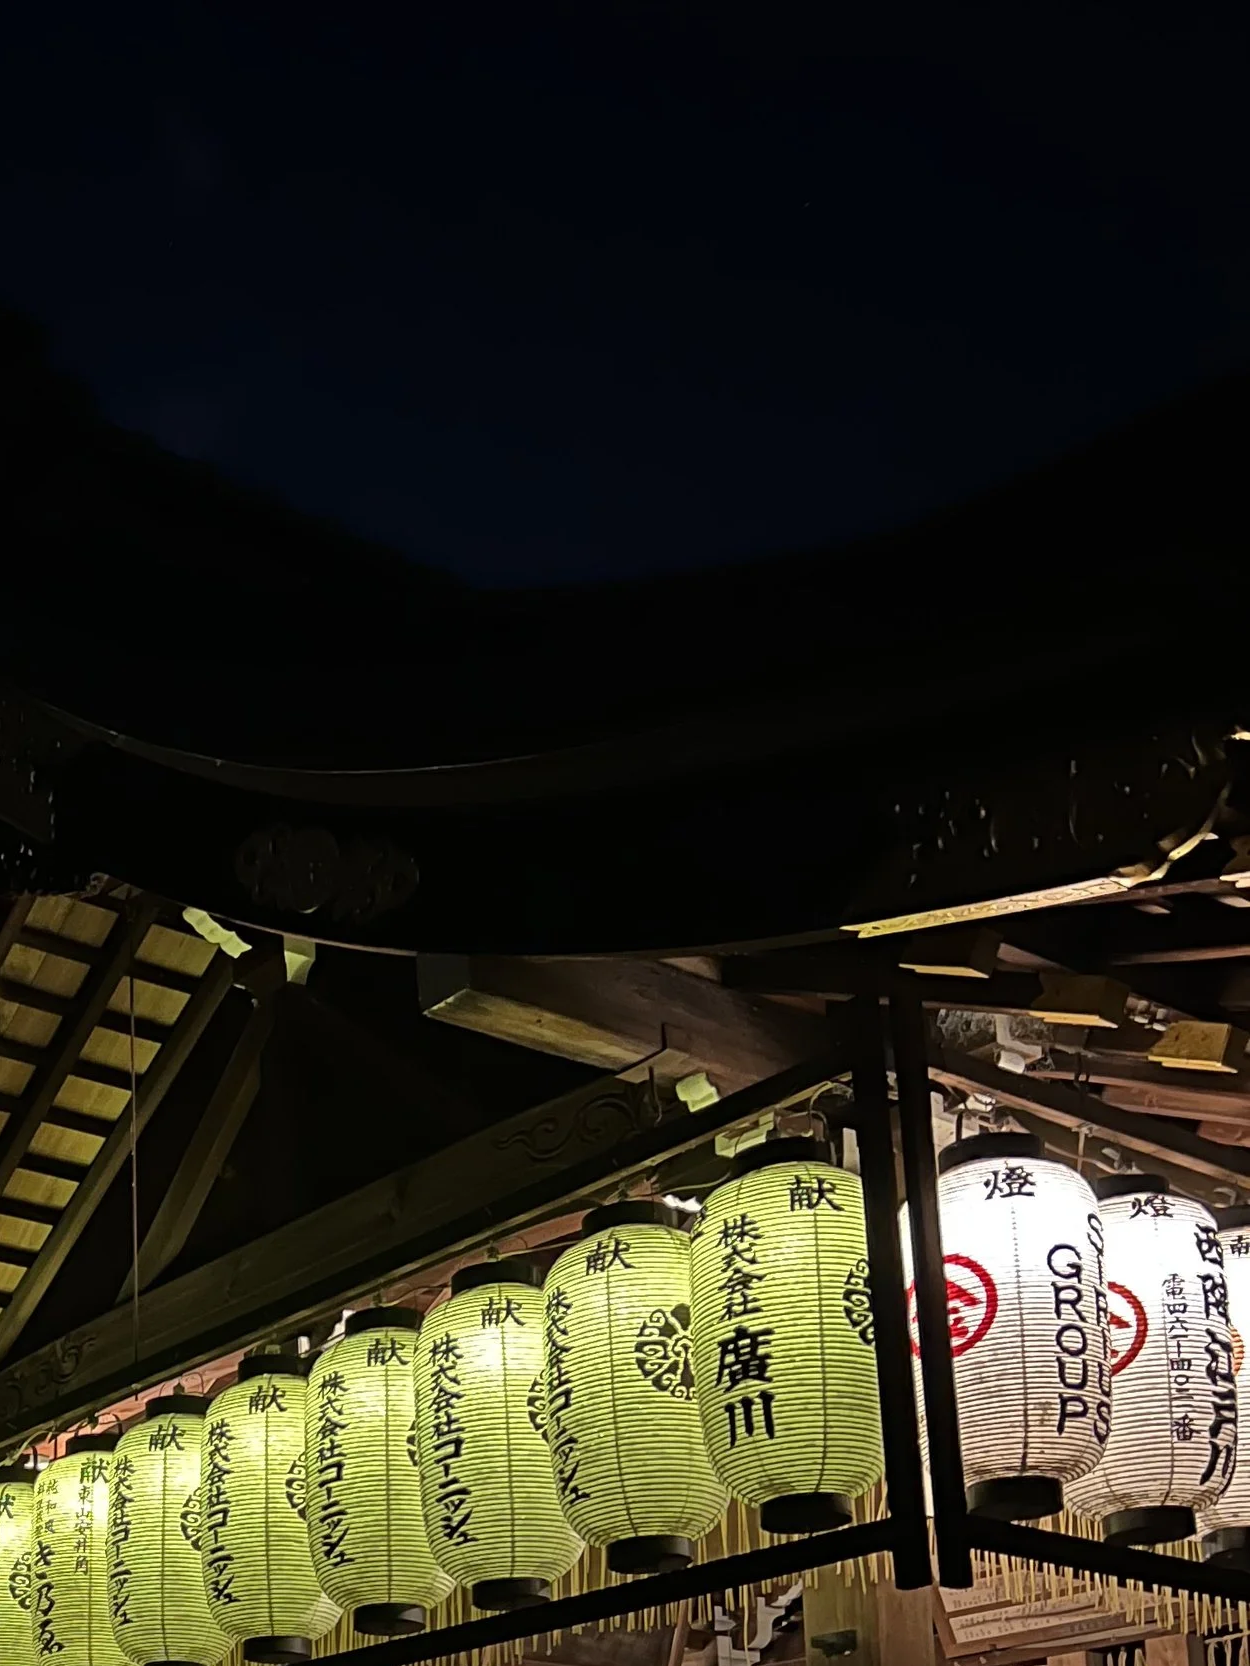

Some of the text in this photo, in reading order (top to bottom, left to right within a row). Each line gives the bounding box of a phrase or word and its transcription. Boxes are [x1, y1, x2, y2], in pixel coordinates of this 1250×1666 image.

[788, 1174, 845, 1212] 献
[984, 1166, 1036, 1200] 燈
[585, 1239, 635, 1276] 献
[480, 1296, 526, 1329] 献
[366, 1338, 410, 1367] 献
[1047, 1243, 1089, 1436] GROUP
[249, 1385, 287, 1414] 献
[149, 1424, 186, 1451] 献
[80, 1456, 111, 1484] 献
